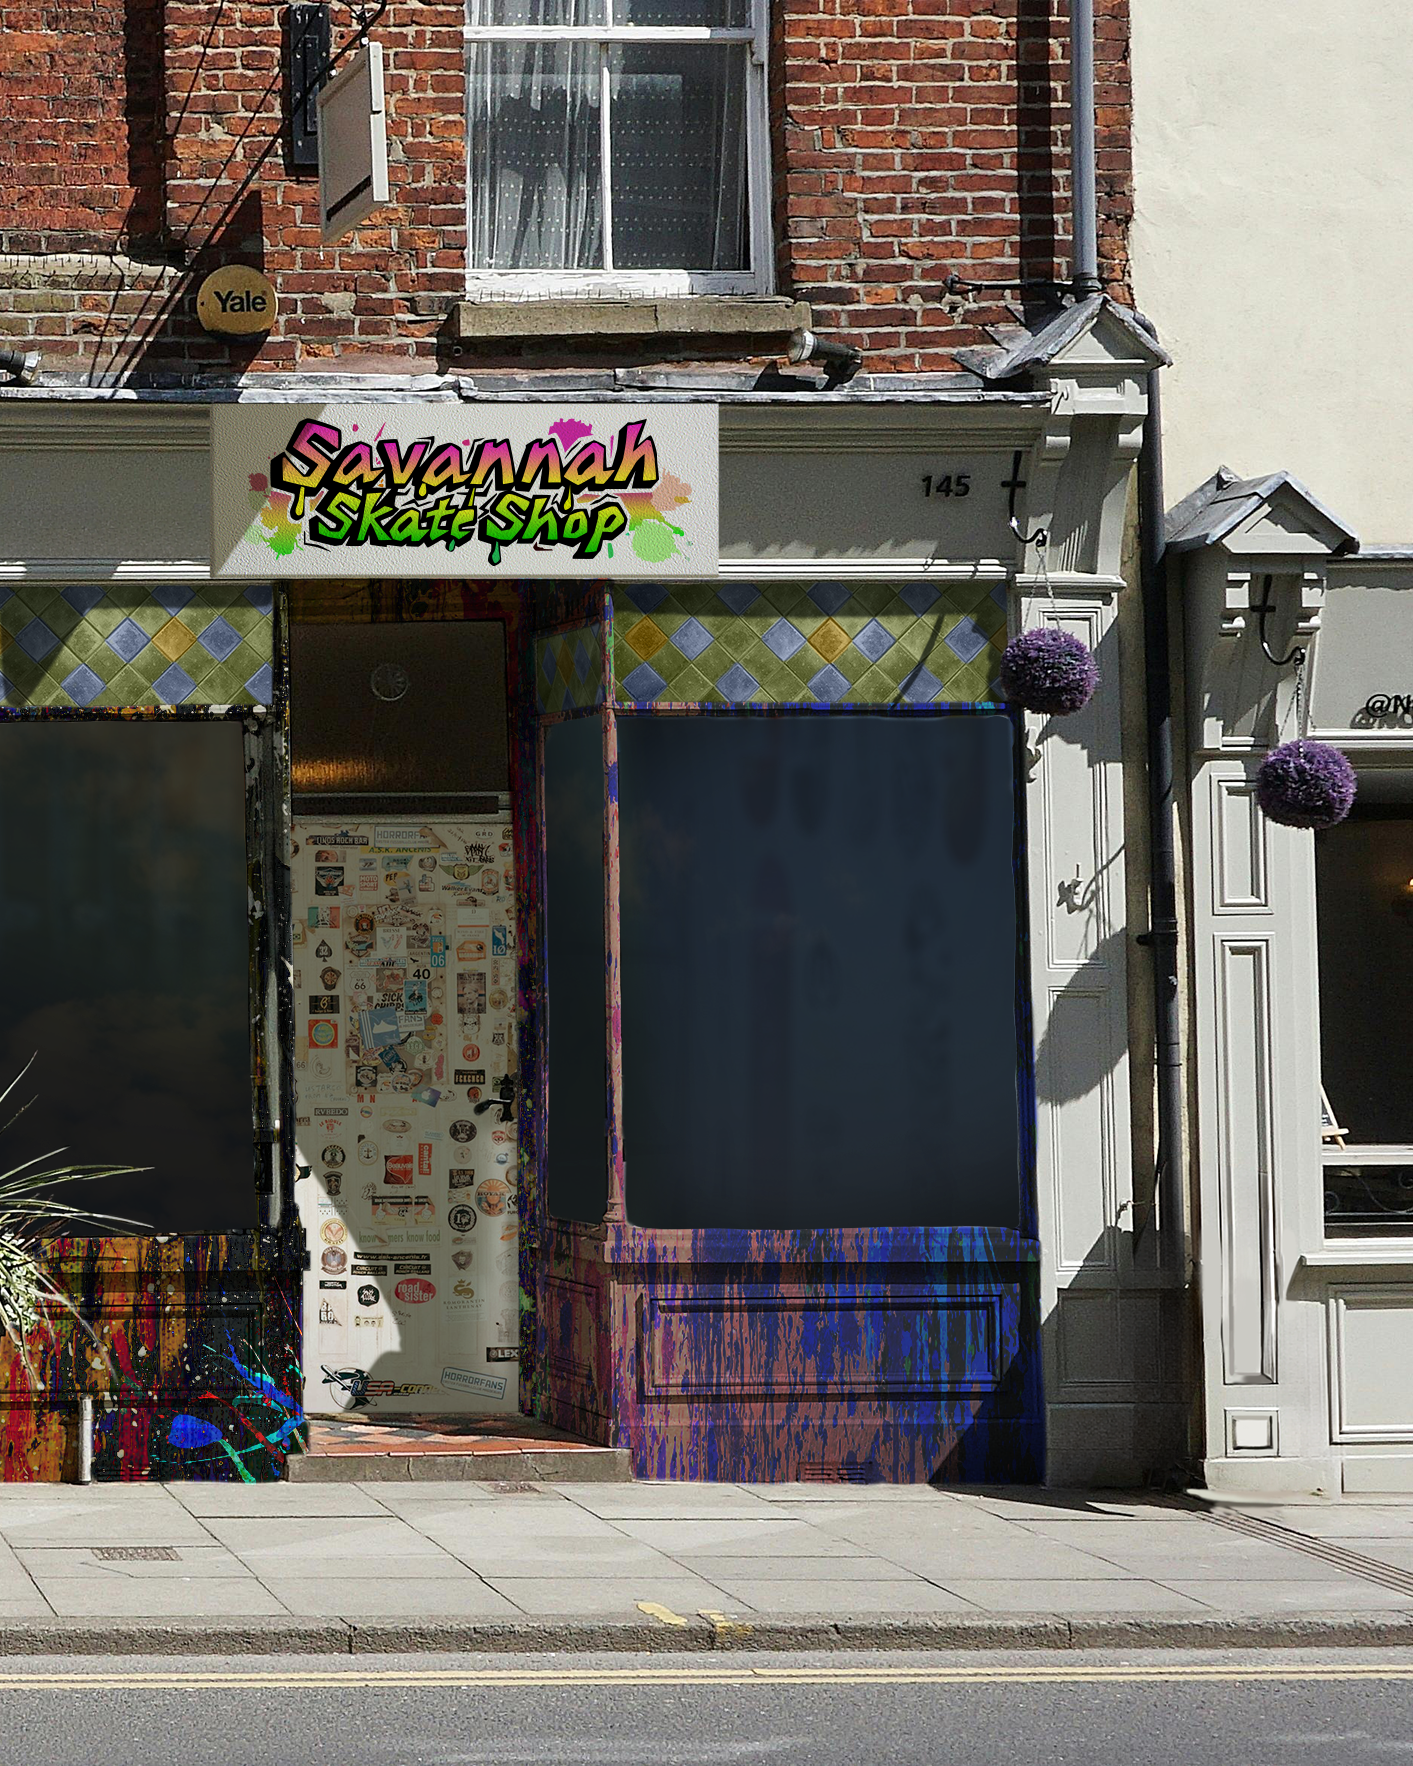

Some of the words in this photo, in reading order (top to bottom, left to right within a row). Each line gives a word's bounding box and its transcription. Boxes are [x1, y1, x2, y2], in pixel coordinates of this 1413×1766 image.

[213, 290, 267, 313] Yale
[271, 418, 659, 492] Savannah
[921, 475, 971, 498] 145
[309, 491, 478, 548] Skate
[485, 491, 629, 560] Shop
[319, 946, 329, 956] 32
[431, 954, 445, 967] 06
[412, 968, 431, 980] 40
[354, 982, 366, 990] 66
[381, 992, 403, 1003] SICK
[358, 1230, 376, 1243] know
[406, 1230, 425, 1242] know
[426, 1229, 441, 1242] food
[397, 1281, 420, 1292] road
[404, 1291, 434, 1302] sister
[443, 1370, 504, 1391] HORRORFANS
